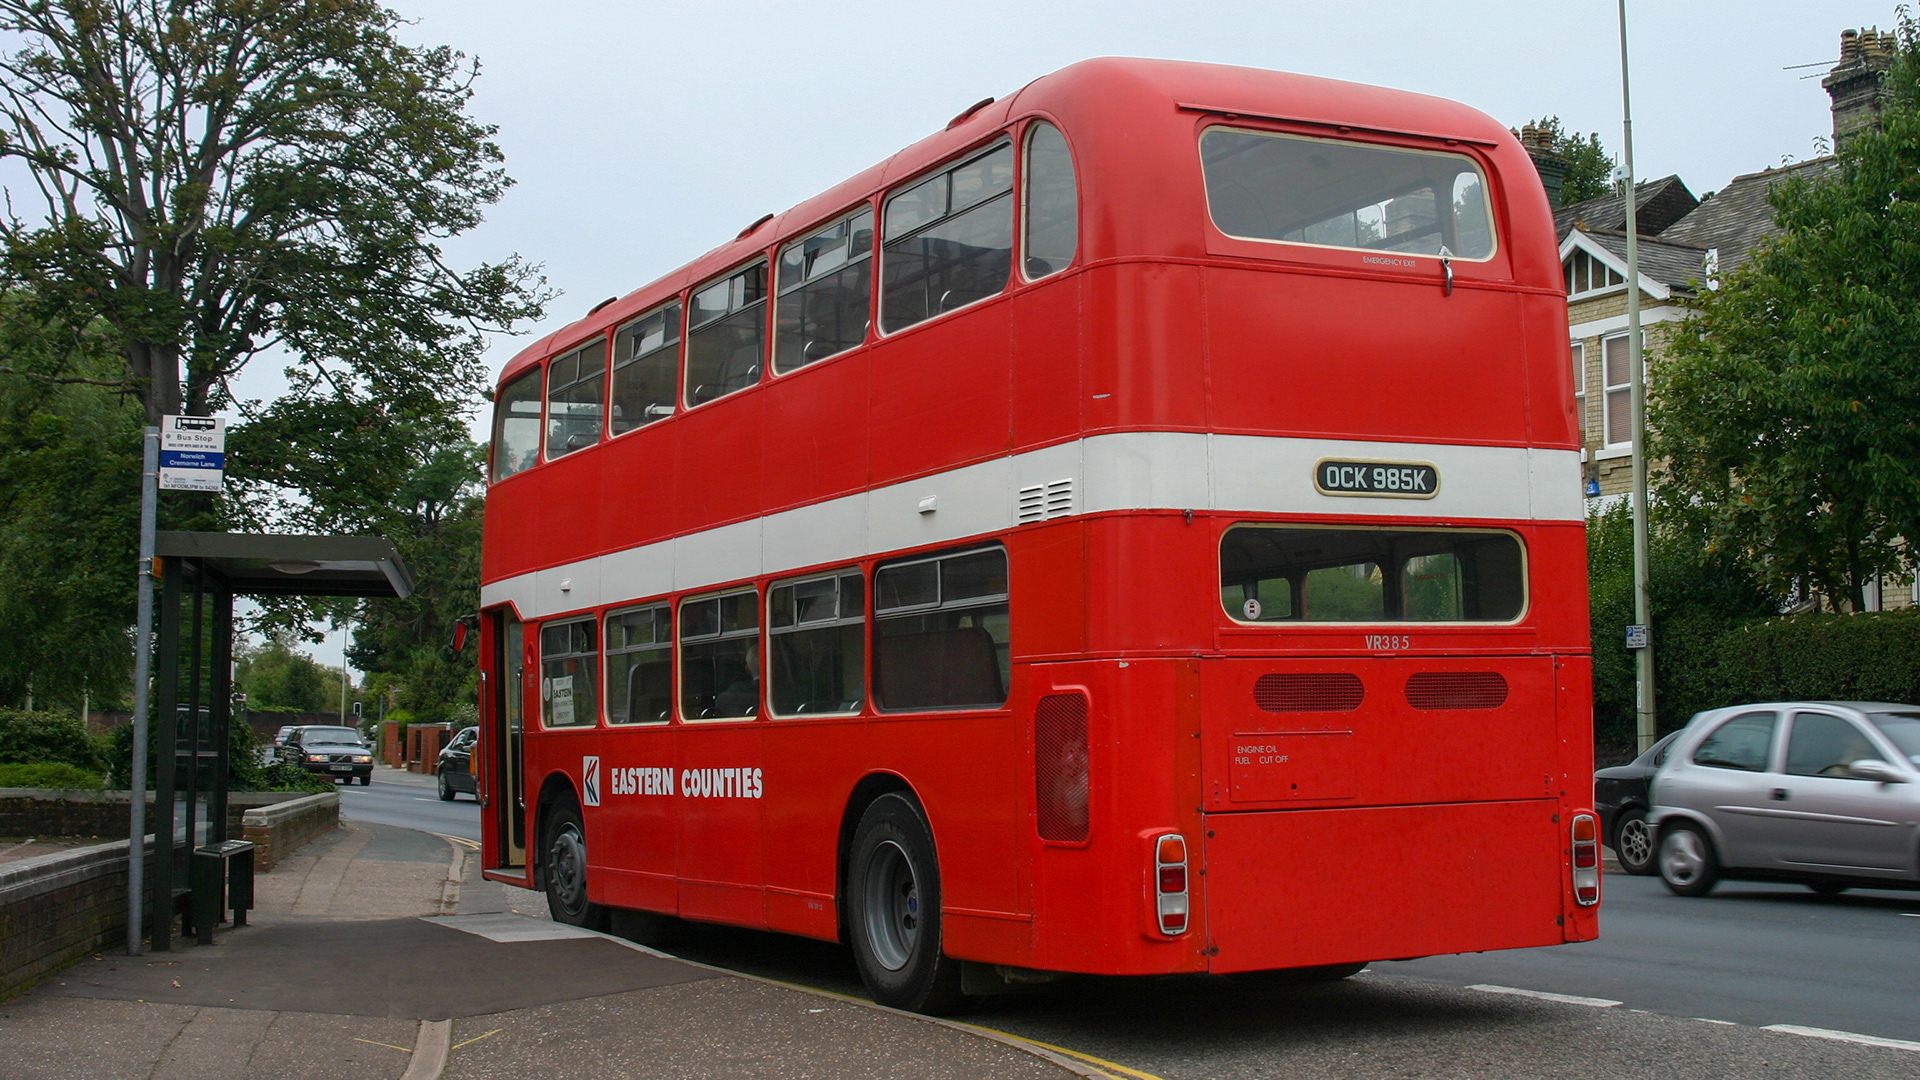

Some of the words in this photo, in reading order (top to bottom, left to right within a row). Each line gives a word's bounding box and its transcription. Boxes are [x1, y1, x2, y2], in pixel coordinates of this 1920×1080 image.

[1362, 256, 1402, 266] EMERGENCY
[1326, 466, 1368, 489] OCK
[1373, 467, 1427, 491] 985K
[1365, 634, 1410, 650] VR385
[1237, 746, 1264, 754] ENGINE
[1266, 745, 1278, 753] OIL
[611, 767, 675, 796] EASTERN
[680, 767, 764, 799] COUNTIES
